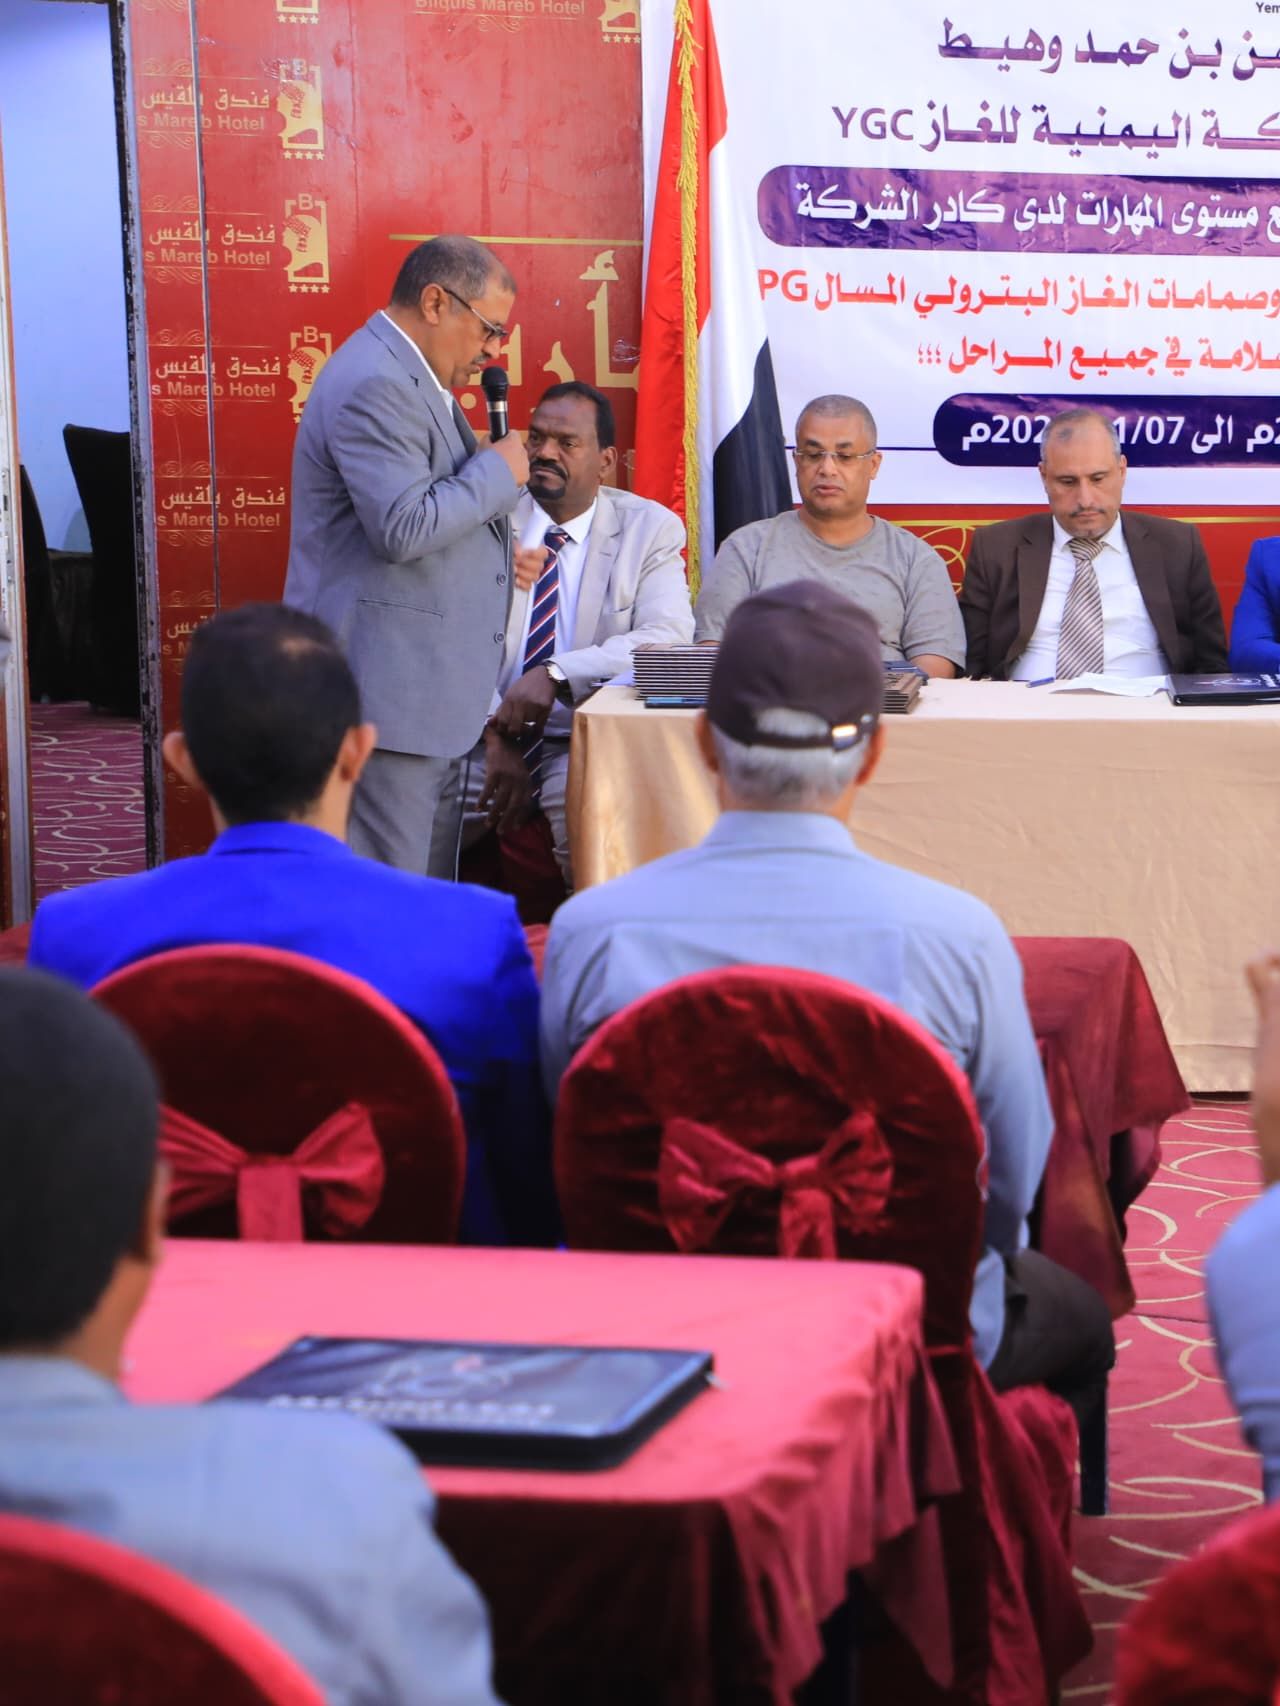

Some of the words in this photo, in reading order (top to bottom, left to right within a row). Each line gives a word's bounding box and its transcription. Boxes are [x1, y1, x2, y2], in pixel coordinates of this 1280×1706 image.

[938, 17, 1062, 73] وهيط
[1074, 29, 1160, 66] حمد
[1169, 28, 1222, 79] بن
[215, 88, 270, 111] فندق
[218, 115, 265, 130] Hotel
[832, 106, 913, 141] YGC
[919, 100, 1021, 153] للغاز
[1032, 103, 1191, 160] اليمنية
[796, 182, 919, 230] الشركة
[923, 187, 1005, 231] كادر
[1013, 190, 1066, 232] لدى
[1075, 191, 1163, 236] المهارات
[1171, 194, 1259, 237] مستوى
[221, 223, 276, 245] فندق
[225, 250, 271, 265] Hotel
[814, 271, 906, 311] المسال
[913, 273, 1059, 319] البترولي
[1062, 274, 1139, 315] الغاز
[226, 356, 281, 378] فندق
[949, 335, 1062, 376] المراحل
[1069, 346, 1159, 380] جميع
[1165, 335, 1192, 377] في
[230, 382, 276, 397] Hotel
[232, 487, 286, 509] فندق
[235, 512, 281, 527] Hotel
